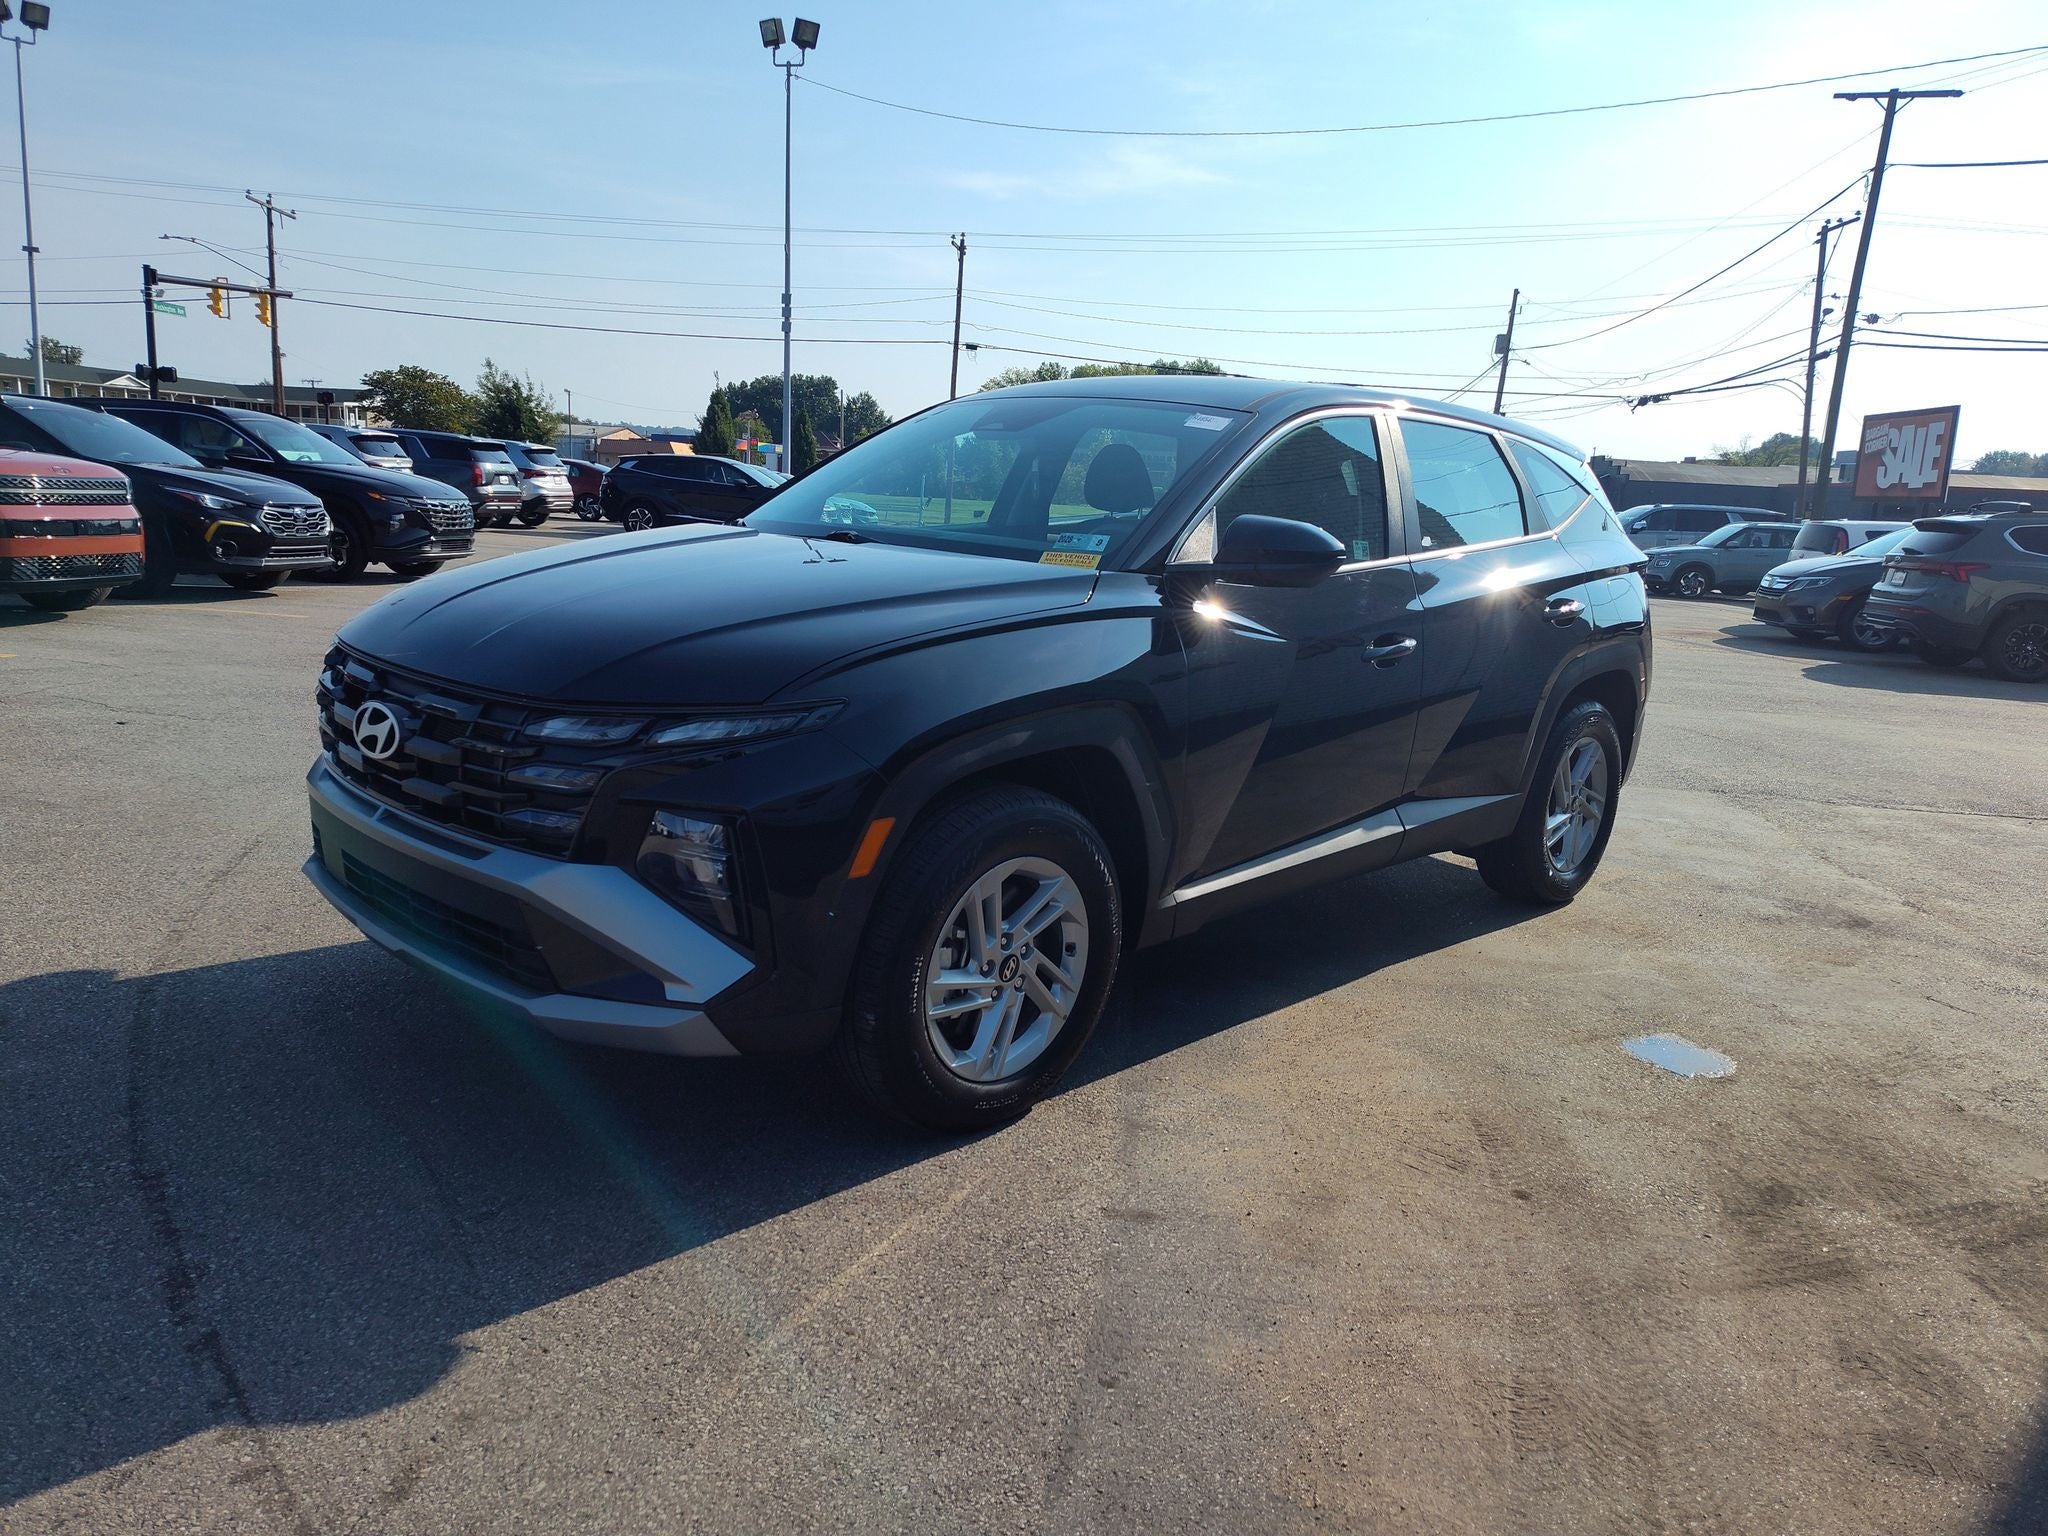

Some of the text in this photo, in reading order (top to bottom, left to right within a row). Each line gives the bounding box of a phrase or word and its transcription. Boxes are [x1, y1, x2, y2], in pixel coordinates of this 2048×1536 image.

[1865, 422, 1890, 441] BARGAIN
[1864, 436, 1888, 454] CORNER
[1876, 421, 1946, 489] SALE
[1096, 538, 1104, 546] 9
[1064, 553, 1096, 561] VEHICLE
